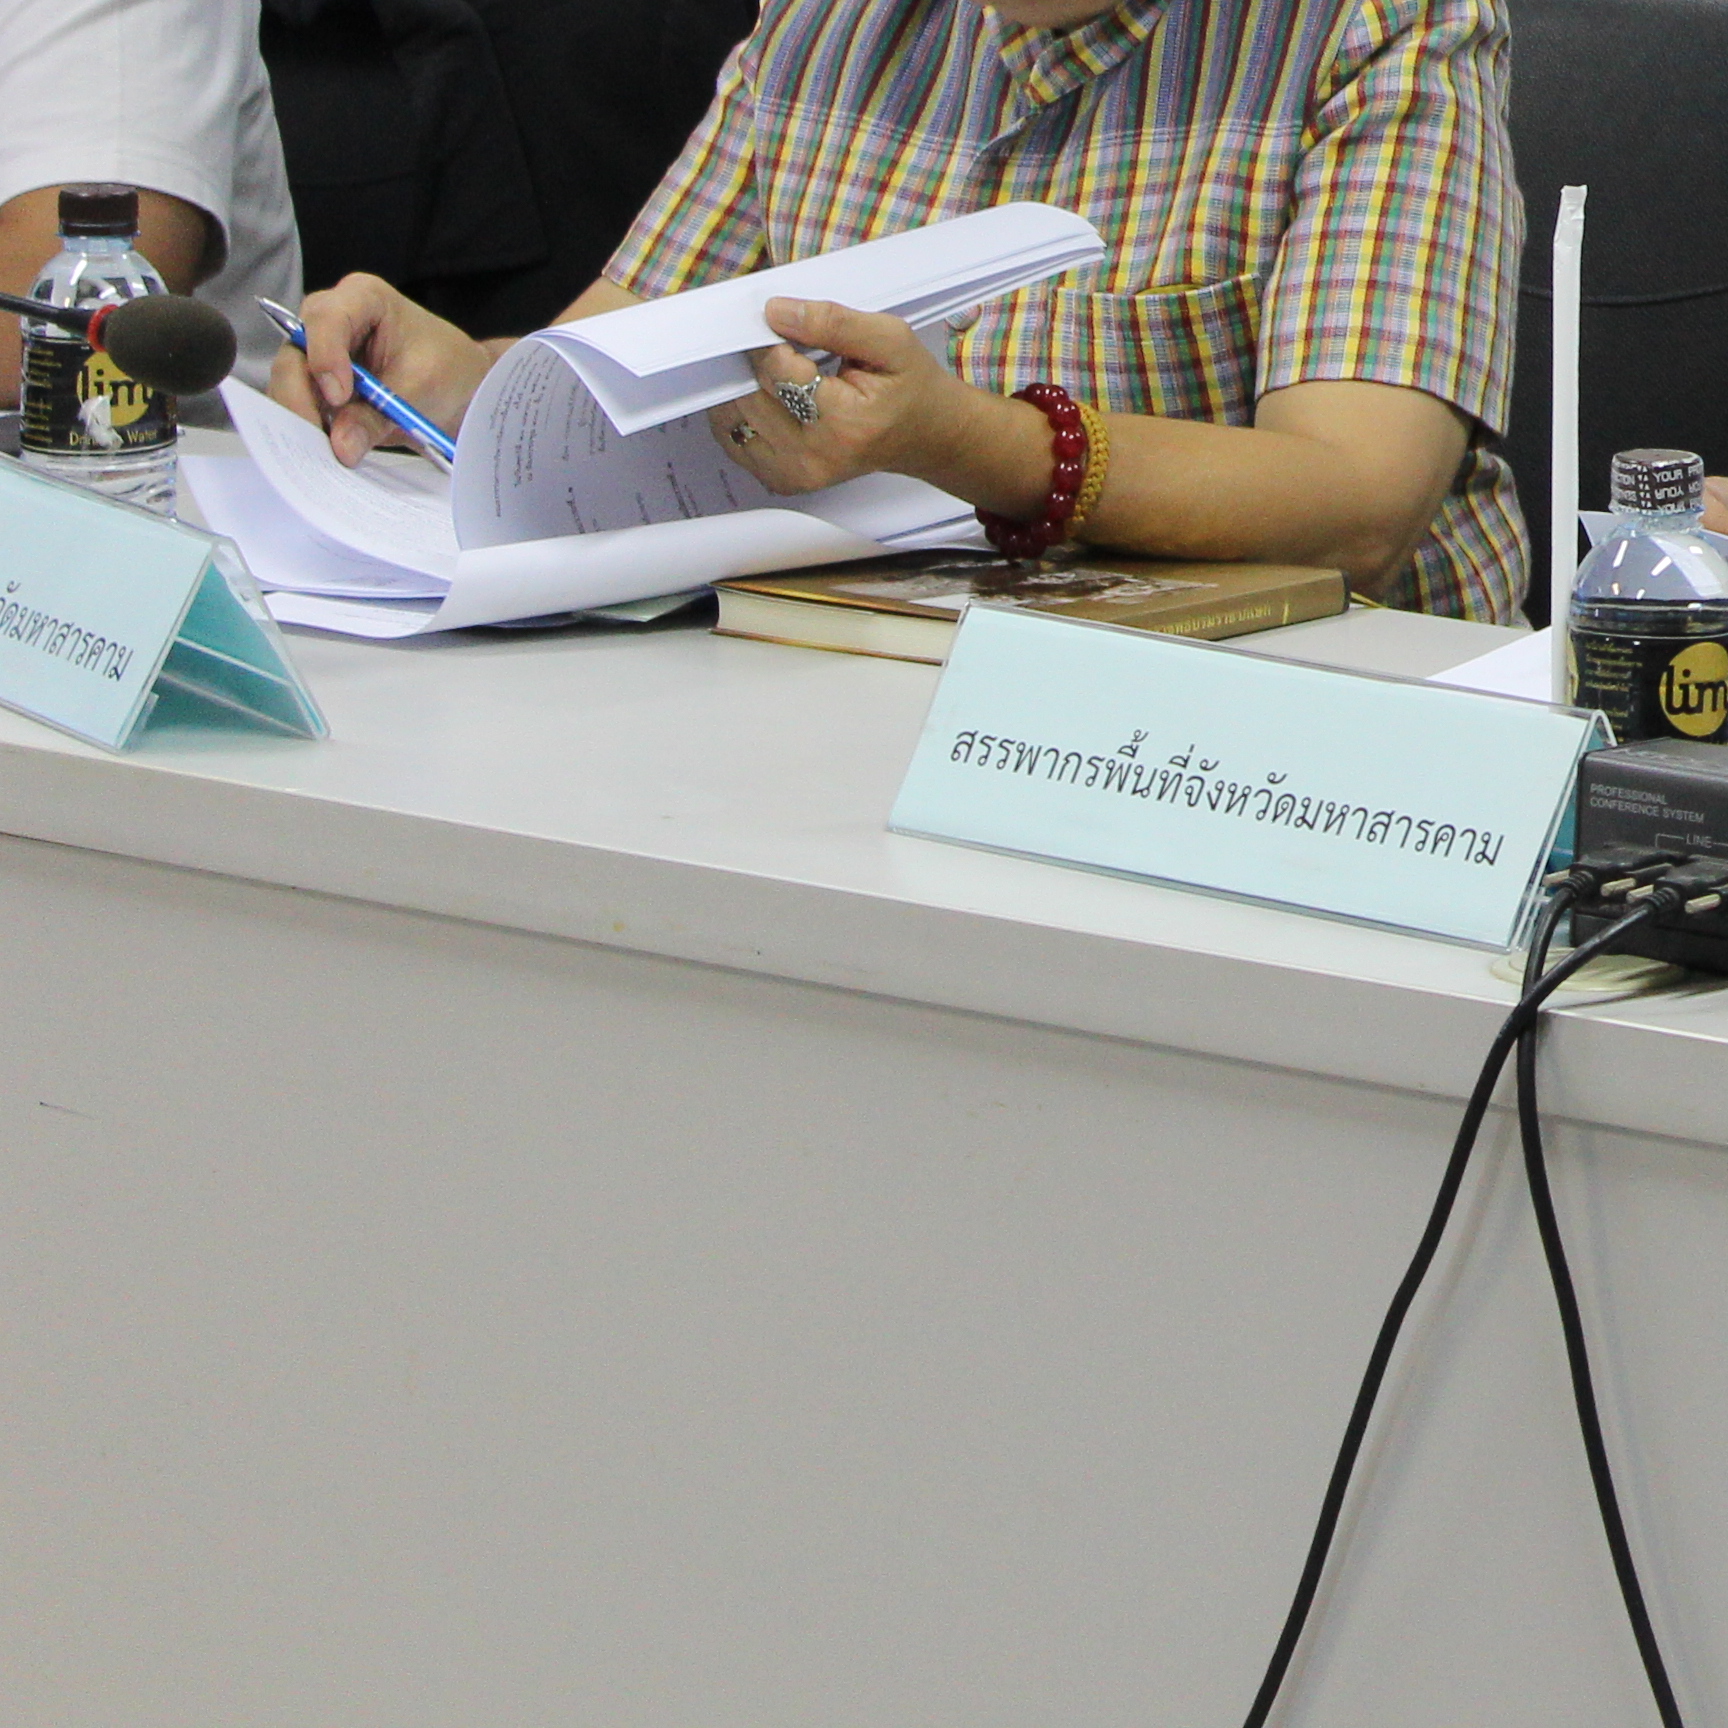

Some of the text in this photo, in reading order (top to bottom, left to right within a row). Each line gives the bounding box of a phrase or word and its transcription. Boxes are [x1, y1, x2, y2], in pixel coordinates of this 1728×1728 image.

[126, 429, 157, 444] Water
[1652, 469, 1683, 483] YOUR
[1665, 664, 1728, 716] lim
[950, 728, 1505, 866] สรรพากรพื้นที่จังหวัดมหาสารคาม
[1590, 783, 1668, 805] PROFESSIONAL
[1590, 797, 1705, 824] CONFERENCE SYSTEM
[1686, 833, 1713, 849] LINE
